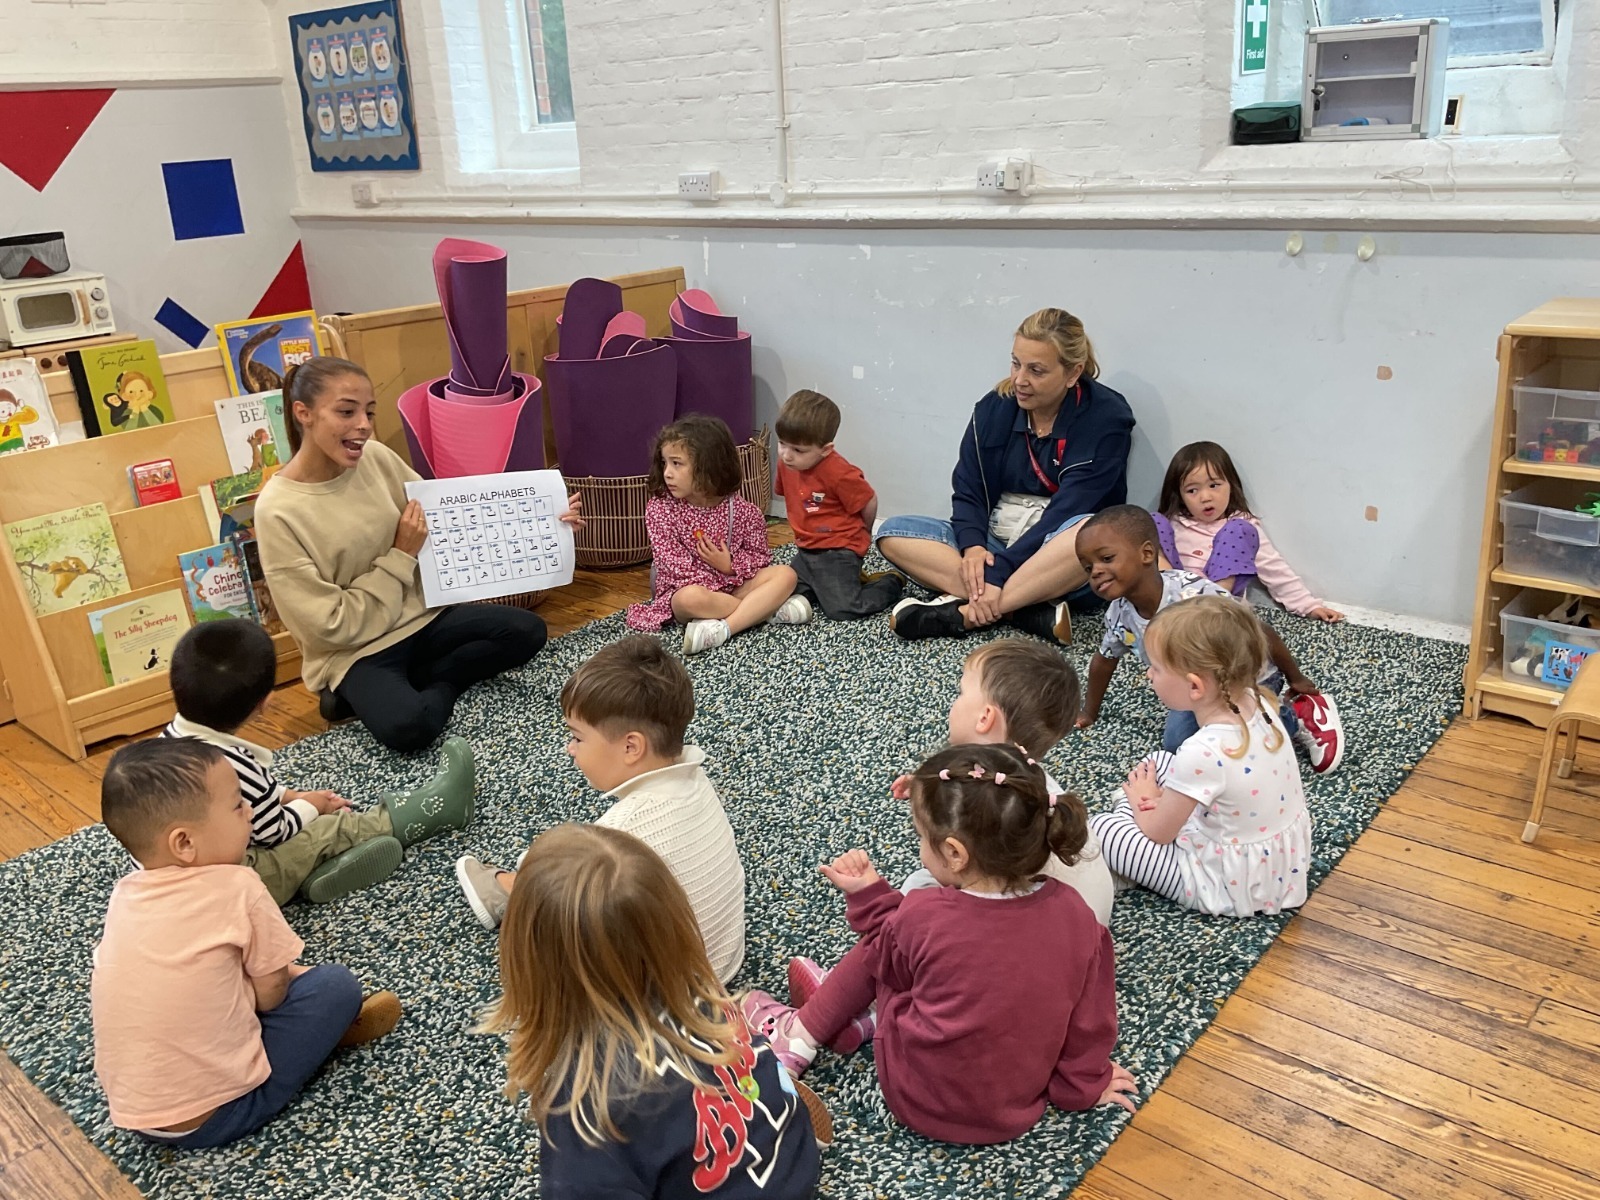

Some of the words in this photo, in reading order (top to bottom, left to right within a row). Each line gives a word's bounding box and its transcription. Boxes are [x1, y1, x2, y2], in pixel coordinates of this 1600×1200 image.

[1246, 49, 1257, 59] First
[282, 343, 310, 354] FIRST
[440, 493, 477, 506] ARABIC
[479, 486, 536, 501] ALPHABETS
[522, 506, 532, 515] ب
[432, 516, 441, 529] خ
[451, 516, 459, 527] ح
[469, 514, 478, 525] ج
[454, 532, 465, 544] ش
[472, 533, 483, 541] س
[493, 528, 499, 540] ز
[511, 529, 517, 538] ر
[433, 537, 448, 546] ص
[544, 540, 558, 551] ض
[458, 553, 469, 562] ف
[494, 547, 504, 558] ع
[441, 555, 449, 567] ق
[499, 567, 507, 577] ن
[445, 577, 453, 587] ي
[114, 630, 127, 640] The
[128, 624, 143, 635] Silly
[143, 614, 178, 629] Sheepdog
